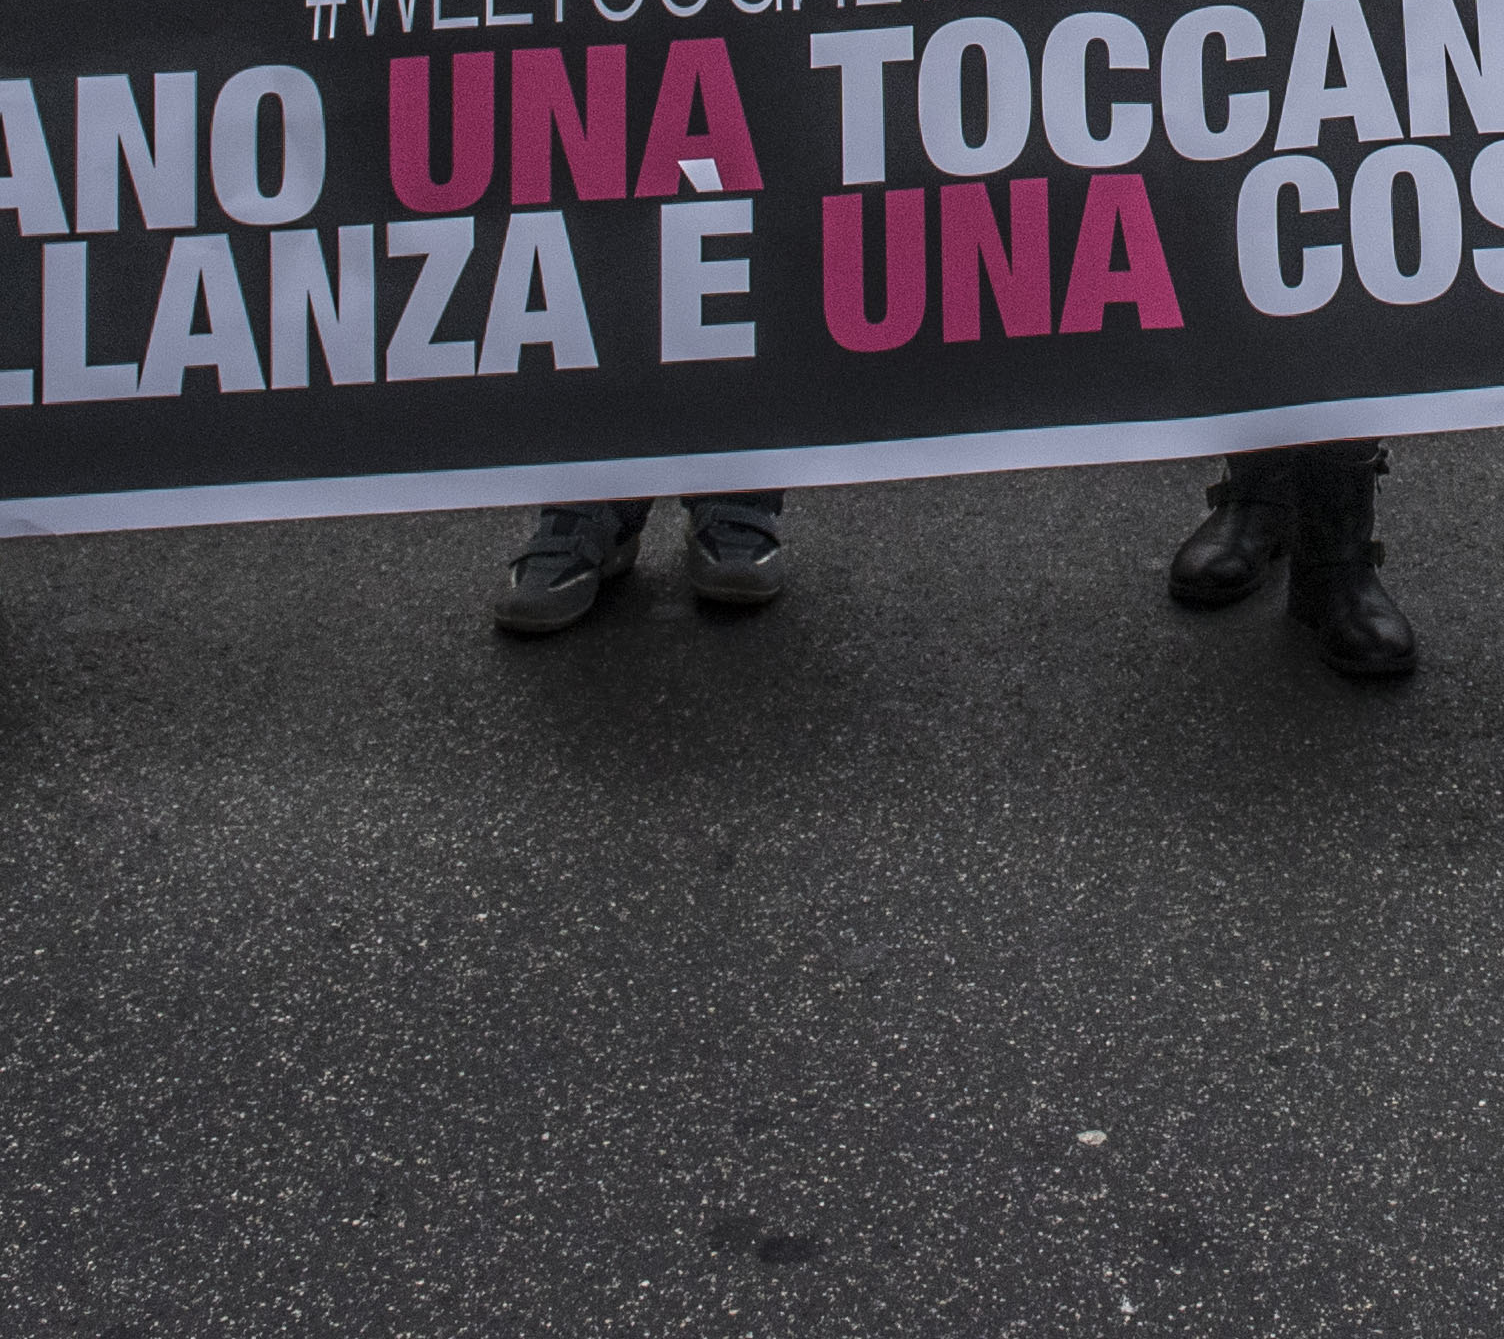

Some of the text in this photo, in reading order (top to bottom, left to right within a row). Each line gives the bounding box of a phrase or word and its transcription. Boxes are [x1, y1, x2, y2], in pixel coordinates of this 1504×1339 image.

[388, 38, 763, 213] UNA
[660, 157, 756, 363] È
[821, 174, 1184, 353] UNA
